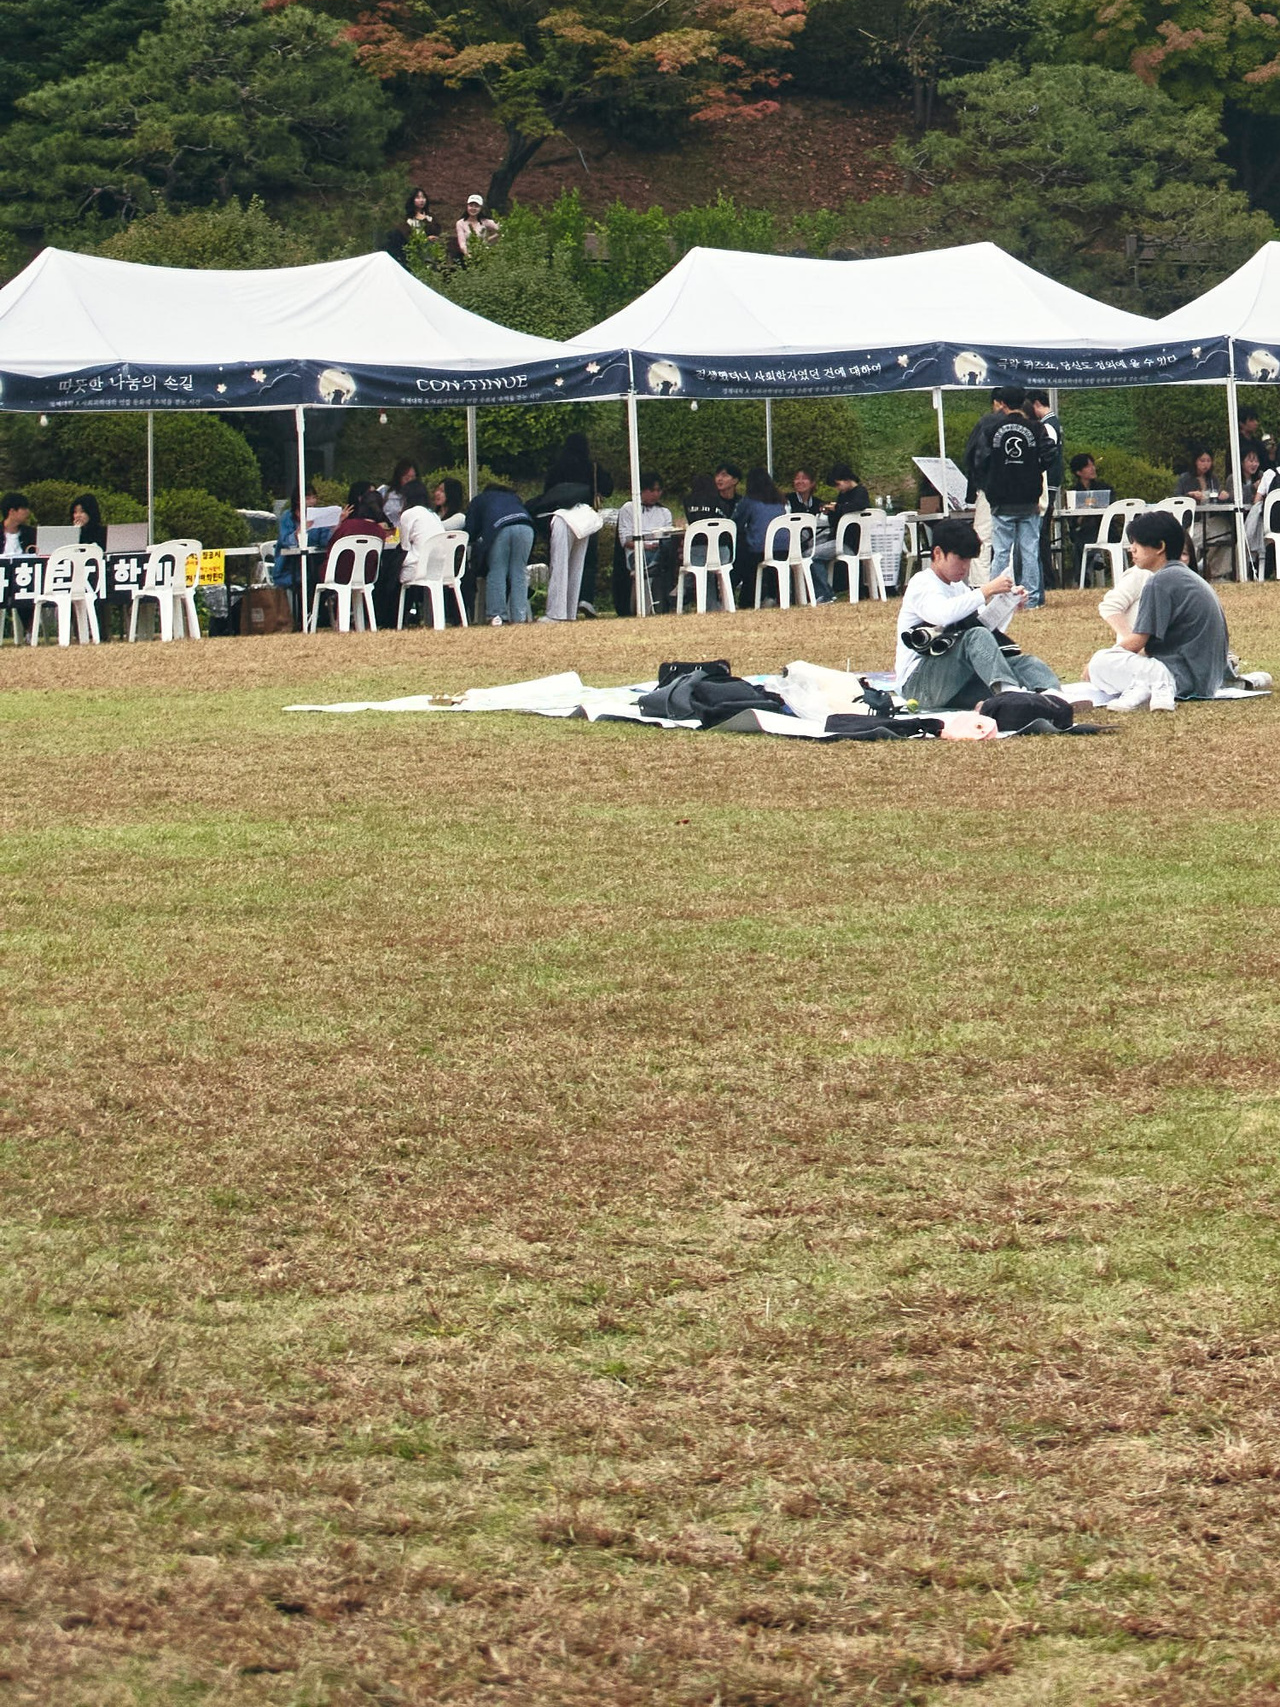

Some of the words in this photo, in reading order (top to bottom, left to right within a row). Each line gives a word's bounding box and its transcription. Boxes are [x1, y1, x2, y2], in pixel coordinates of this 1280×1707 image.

[1060, 360, 1094, 371] 당신도
[1143, 357, 1155, 367] 수
[1156, 354, 1178, 366] 있다
[754, 368, 821, 382] 사회학자였던
[823, 366, 847, 379] 건에
[59, 375, 103, 394] 따뜻한
[109, 373, 156, 392] 나눔의
[163, 374, 194, 392] 손길
